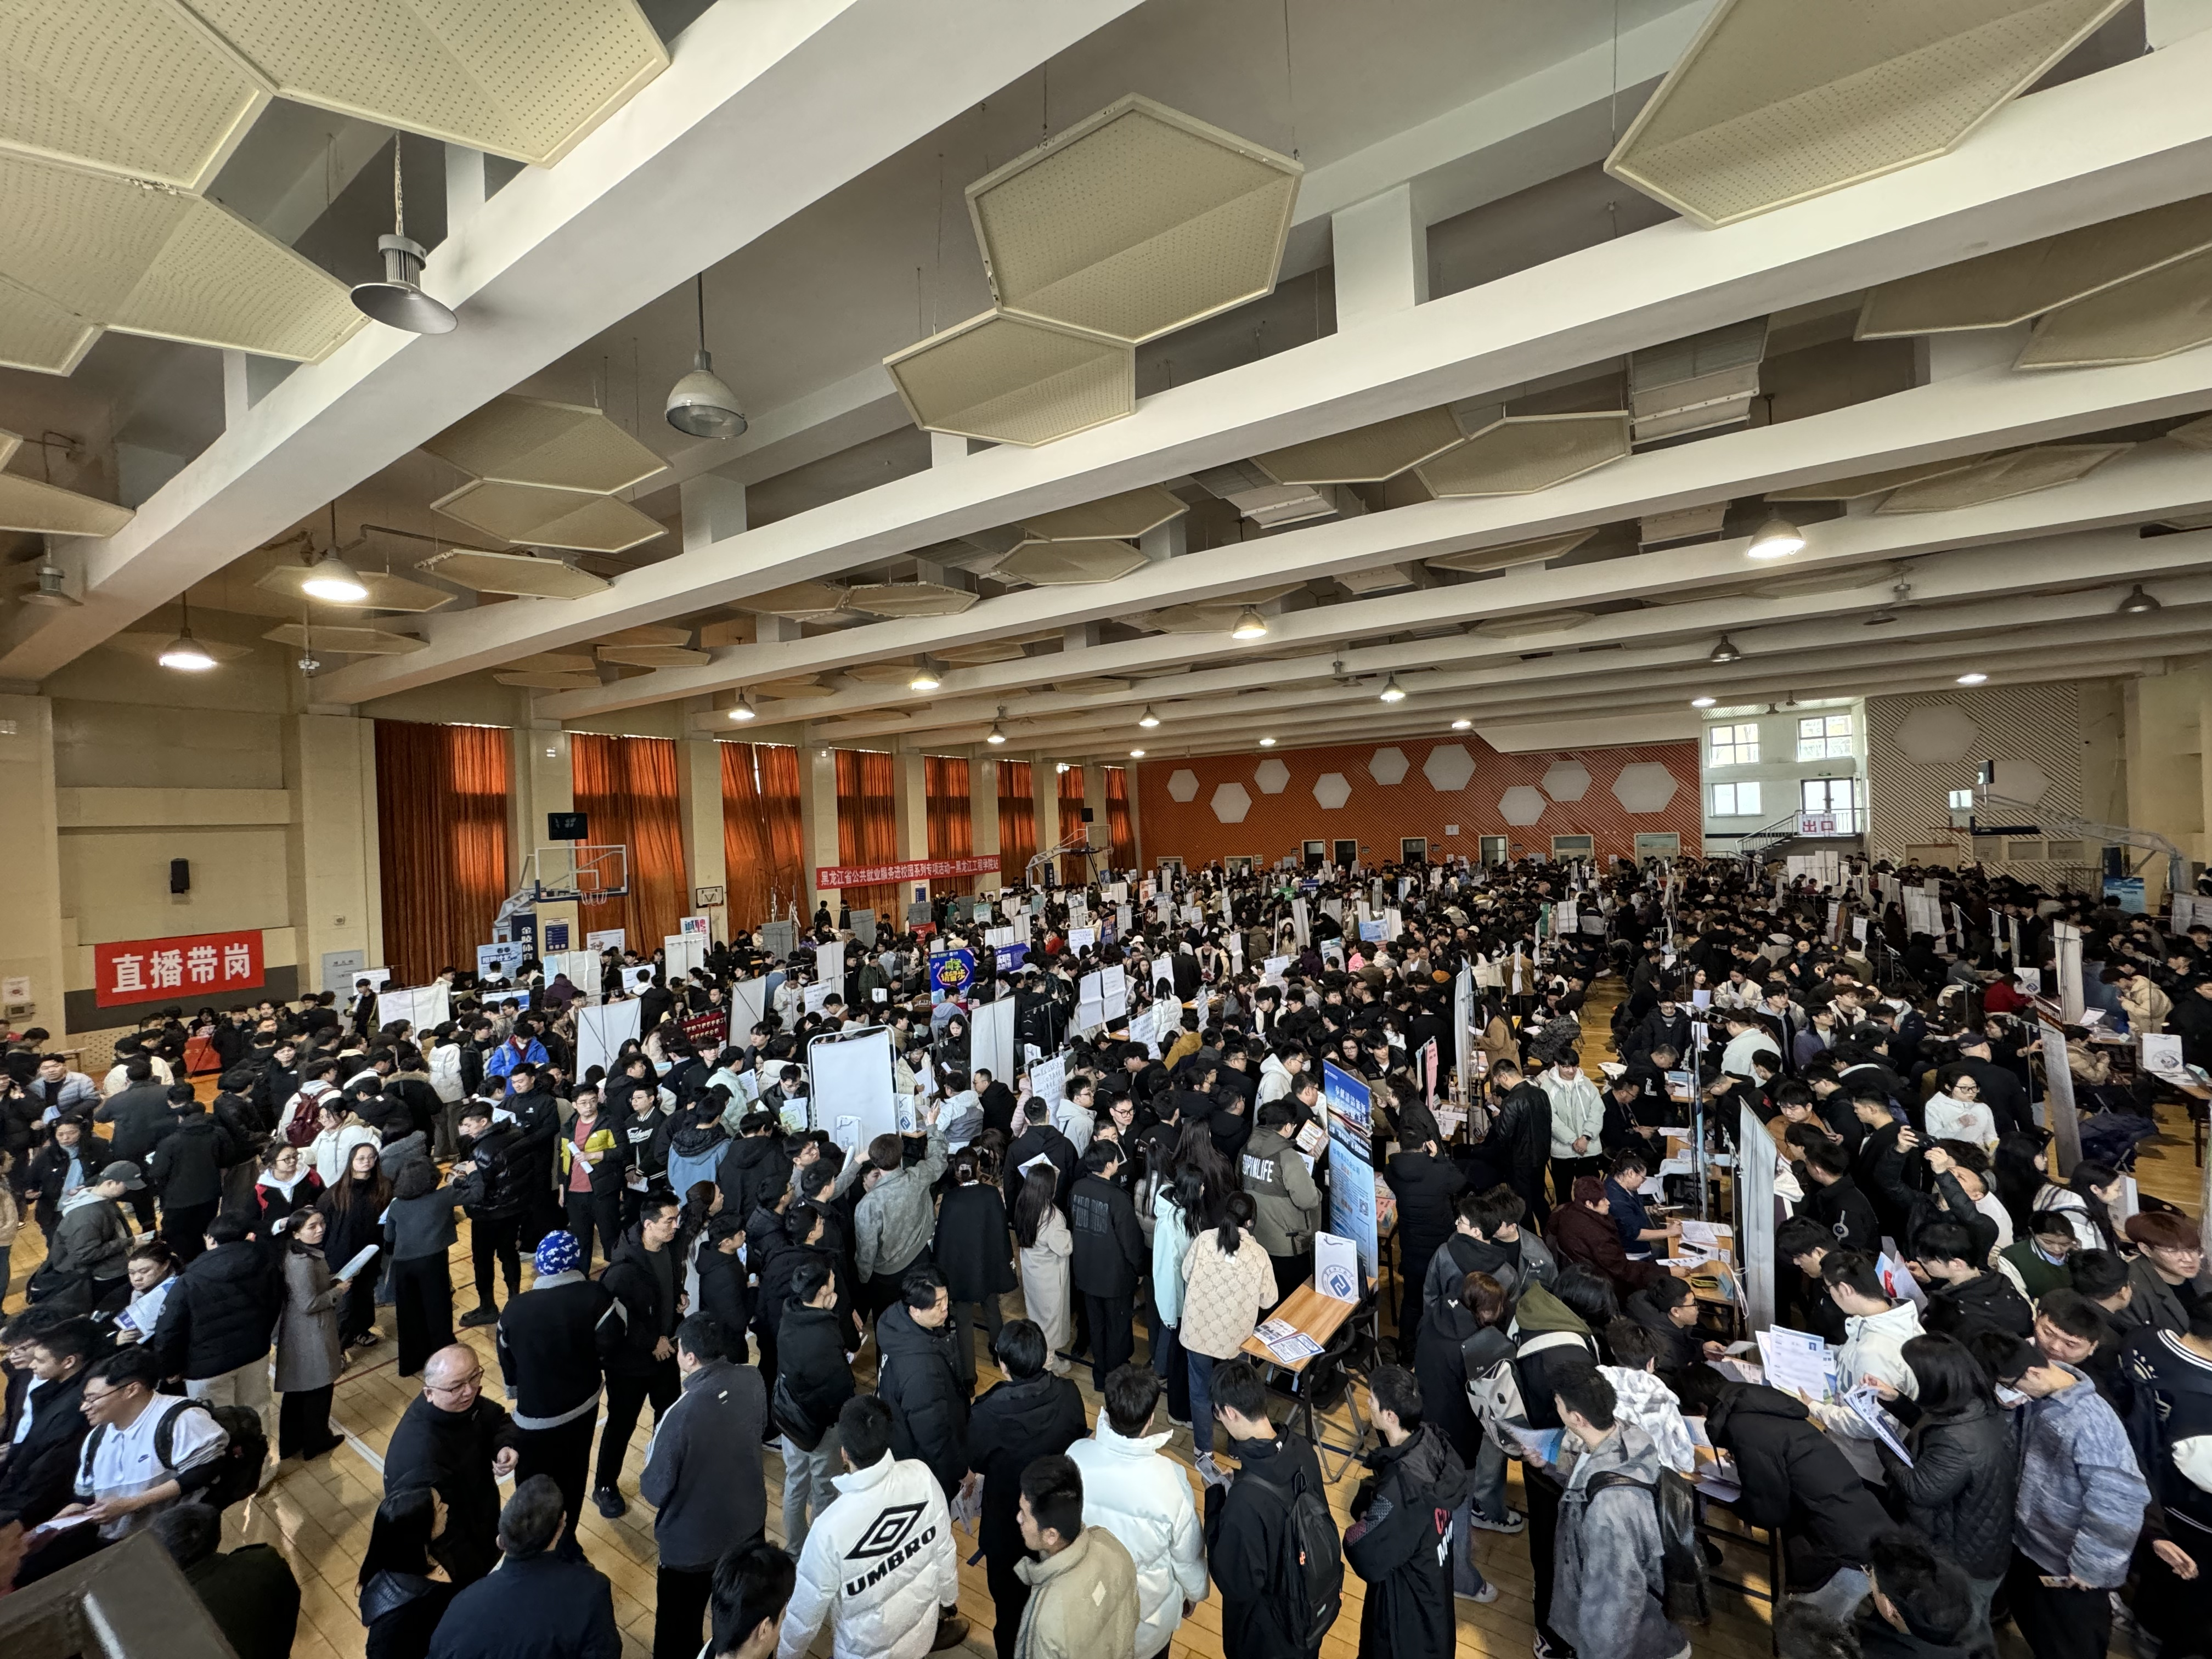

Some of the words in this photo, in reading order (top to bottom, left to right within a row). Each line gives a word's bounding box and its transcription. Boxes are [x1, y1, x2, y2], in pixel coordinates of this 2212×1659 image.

[1803, 820, 1833, 832] 出口
[112, 943, 251, 994] 直播带岗
[945, 957, 962, 970] 同学
[941, 969, 965, 982] 请留步
[847, 1525, 936, 1596] UMBRO
